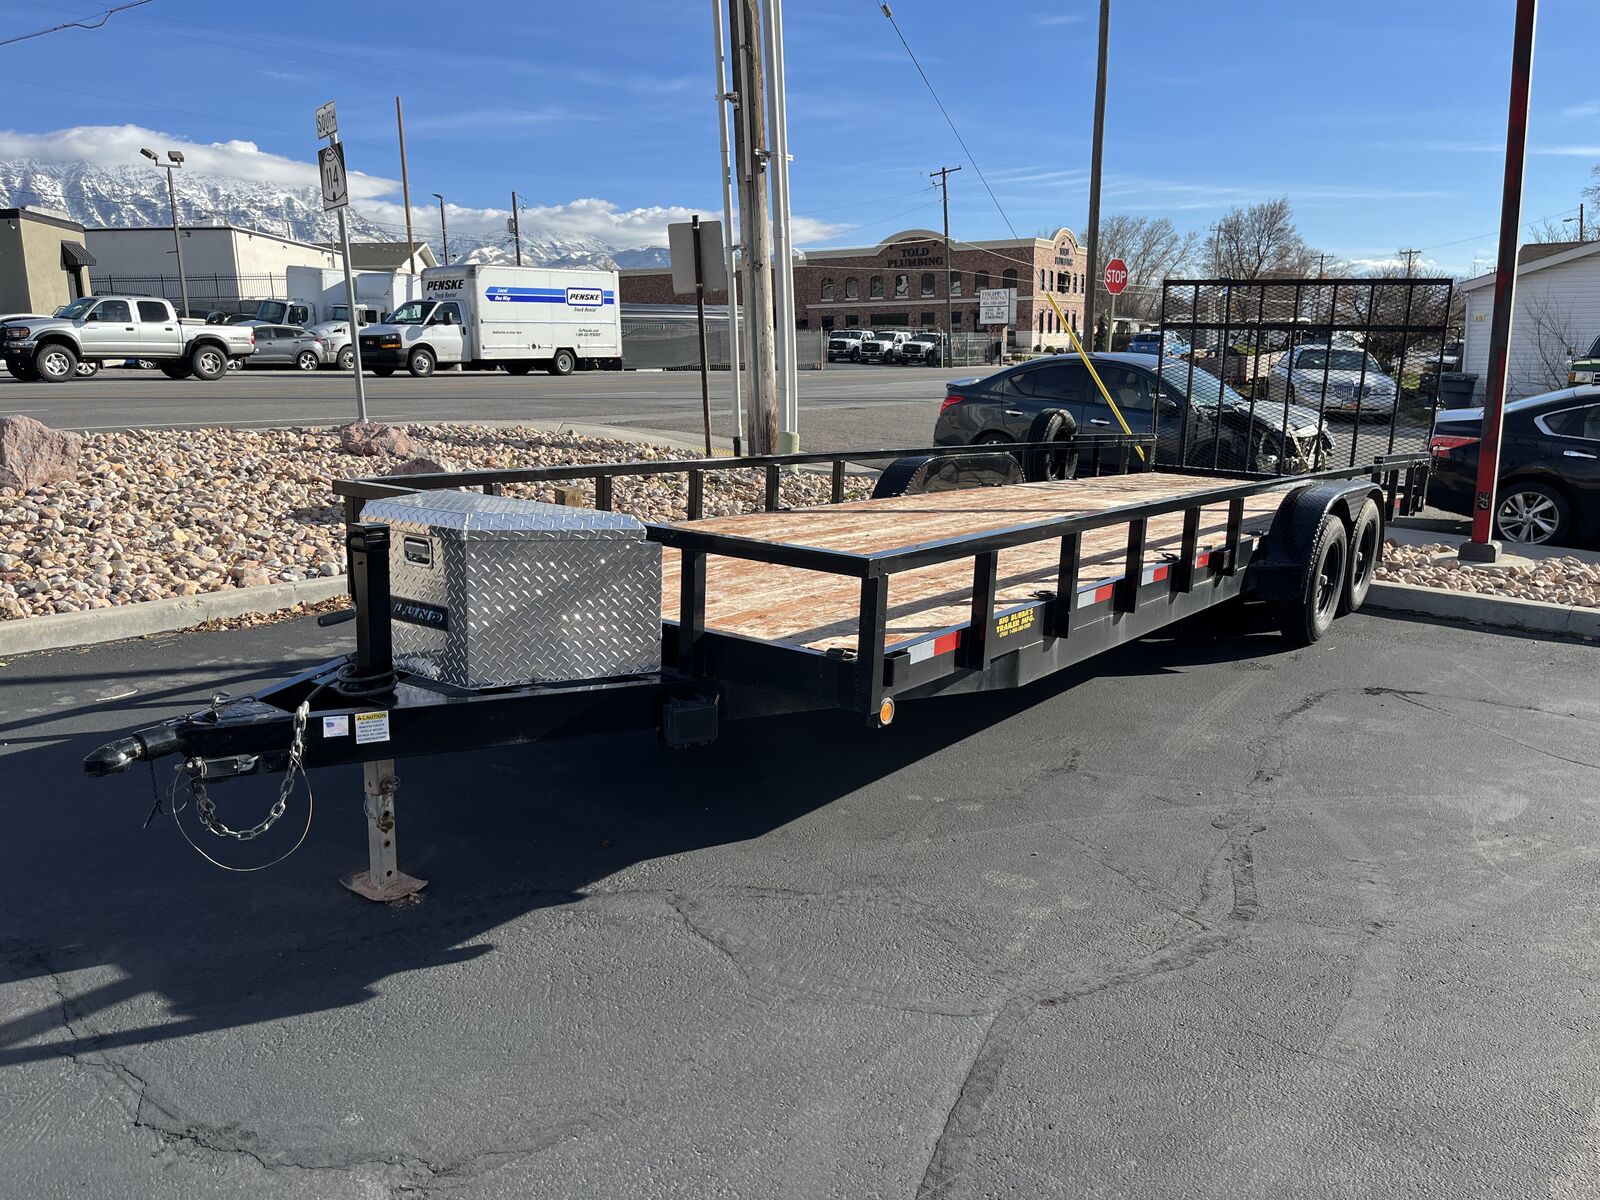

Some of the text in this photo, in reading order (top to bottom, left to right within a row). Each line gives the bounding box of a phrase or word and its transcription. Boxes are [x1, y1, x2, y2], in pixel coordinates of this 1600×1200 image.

[316, 111, 335, 133] SOUTH
[326, 165, 339, 190] 114
[901, 248, 929, 257] TOLD
[887, 256, 943, 268] PLUMBING
[1106, 270, 1127, 283] STOP
[427, 279, 464, 290] PENSKE
[570, 293, 600, 301] PENSKE
[998, 607, 1034, 625] BIG BUBBA'S
[996, 619, 1020, 634] TRAILER
[1021, 614, 1035, 624] MFG.
